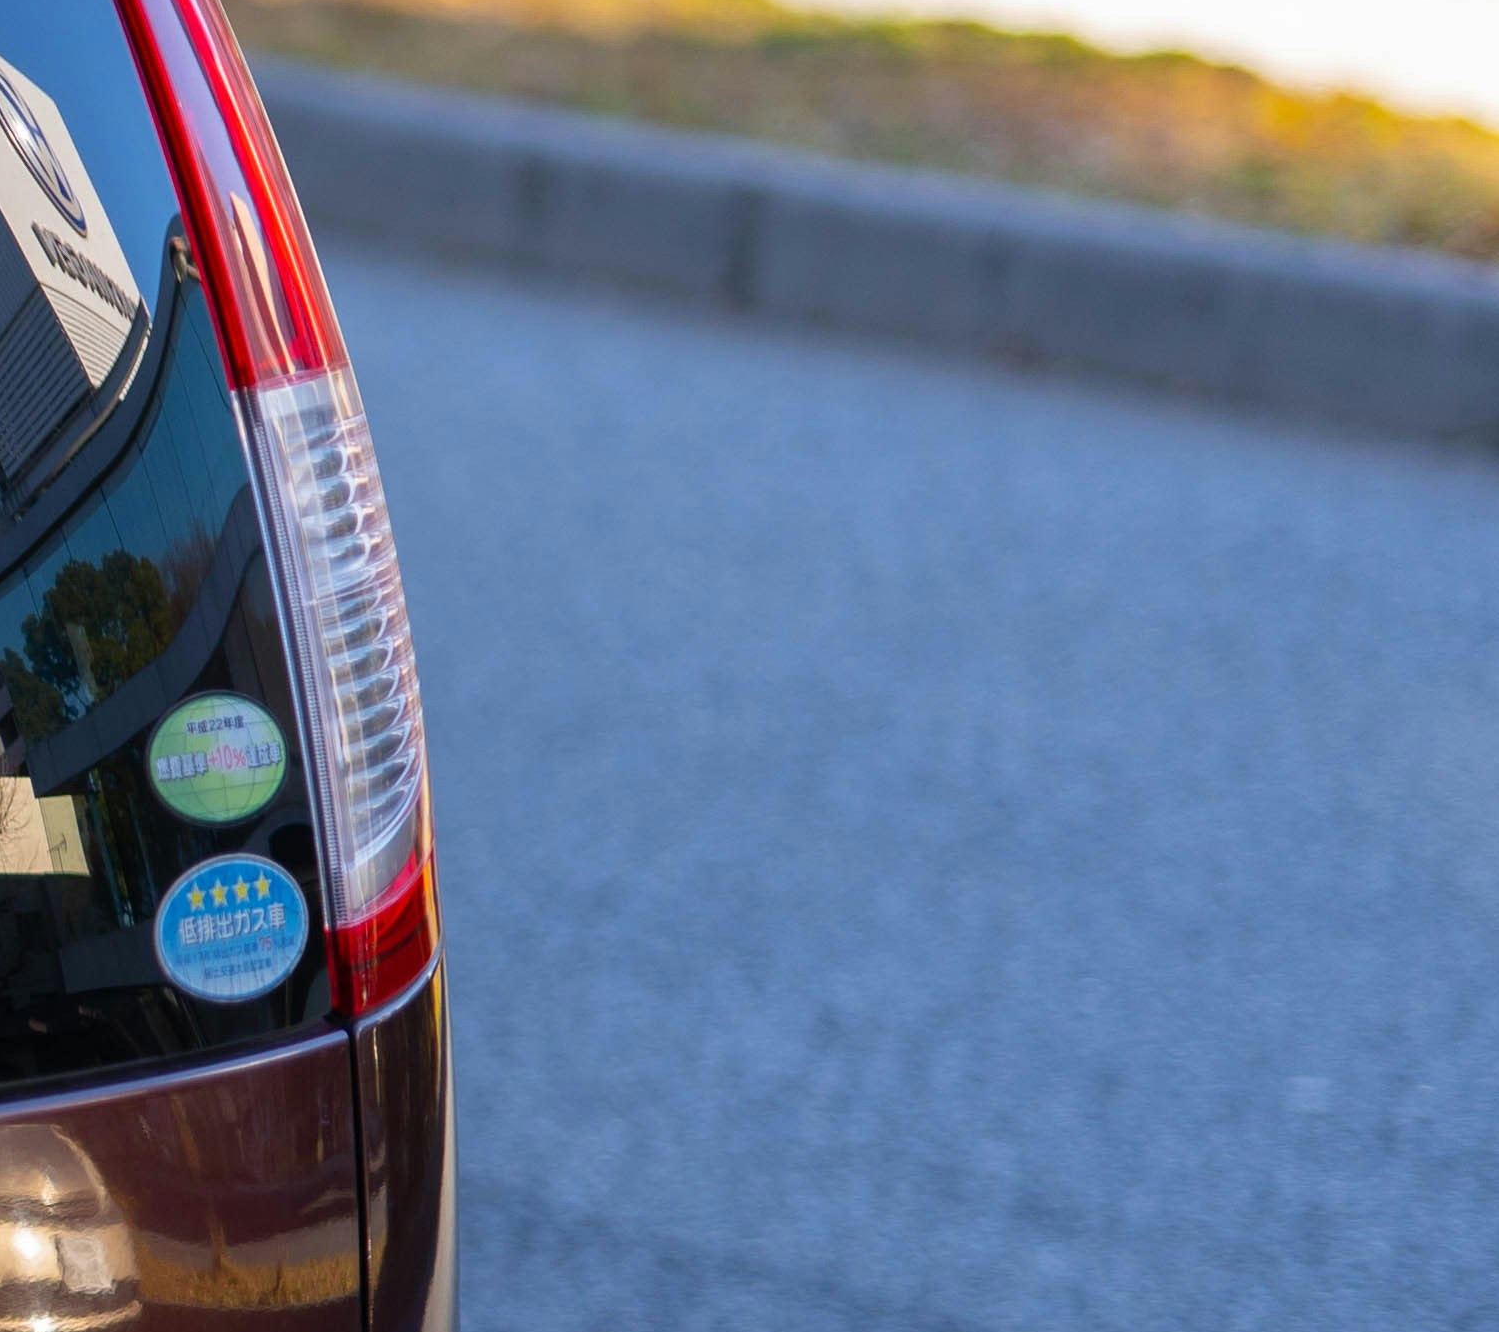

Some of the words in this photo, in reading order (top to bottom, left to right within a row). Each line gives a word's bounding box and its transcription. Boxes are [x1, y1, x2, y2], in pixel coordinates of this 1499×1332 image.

[186, 715, 244, 734] 平成22年度
[180, 901, 286, 947] 低排出ガス車
